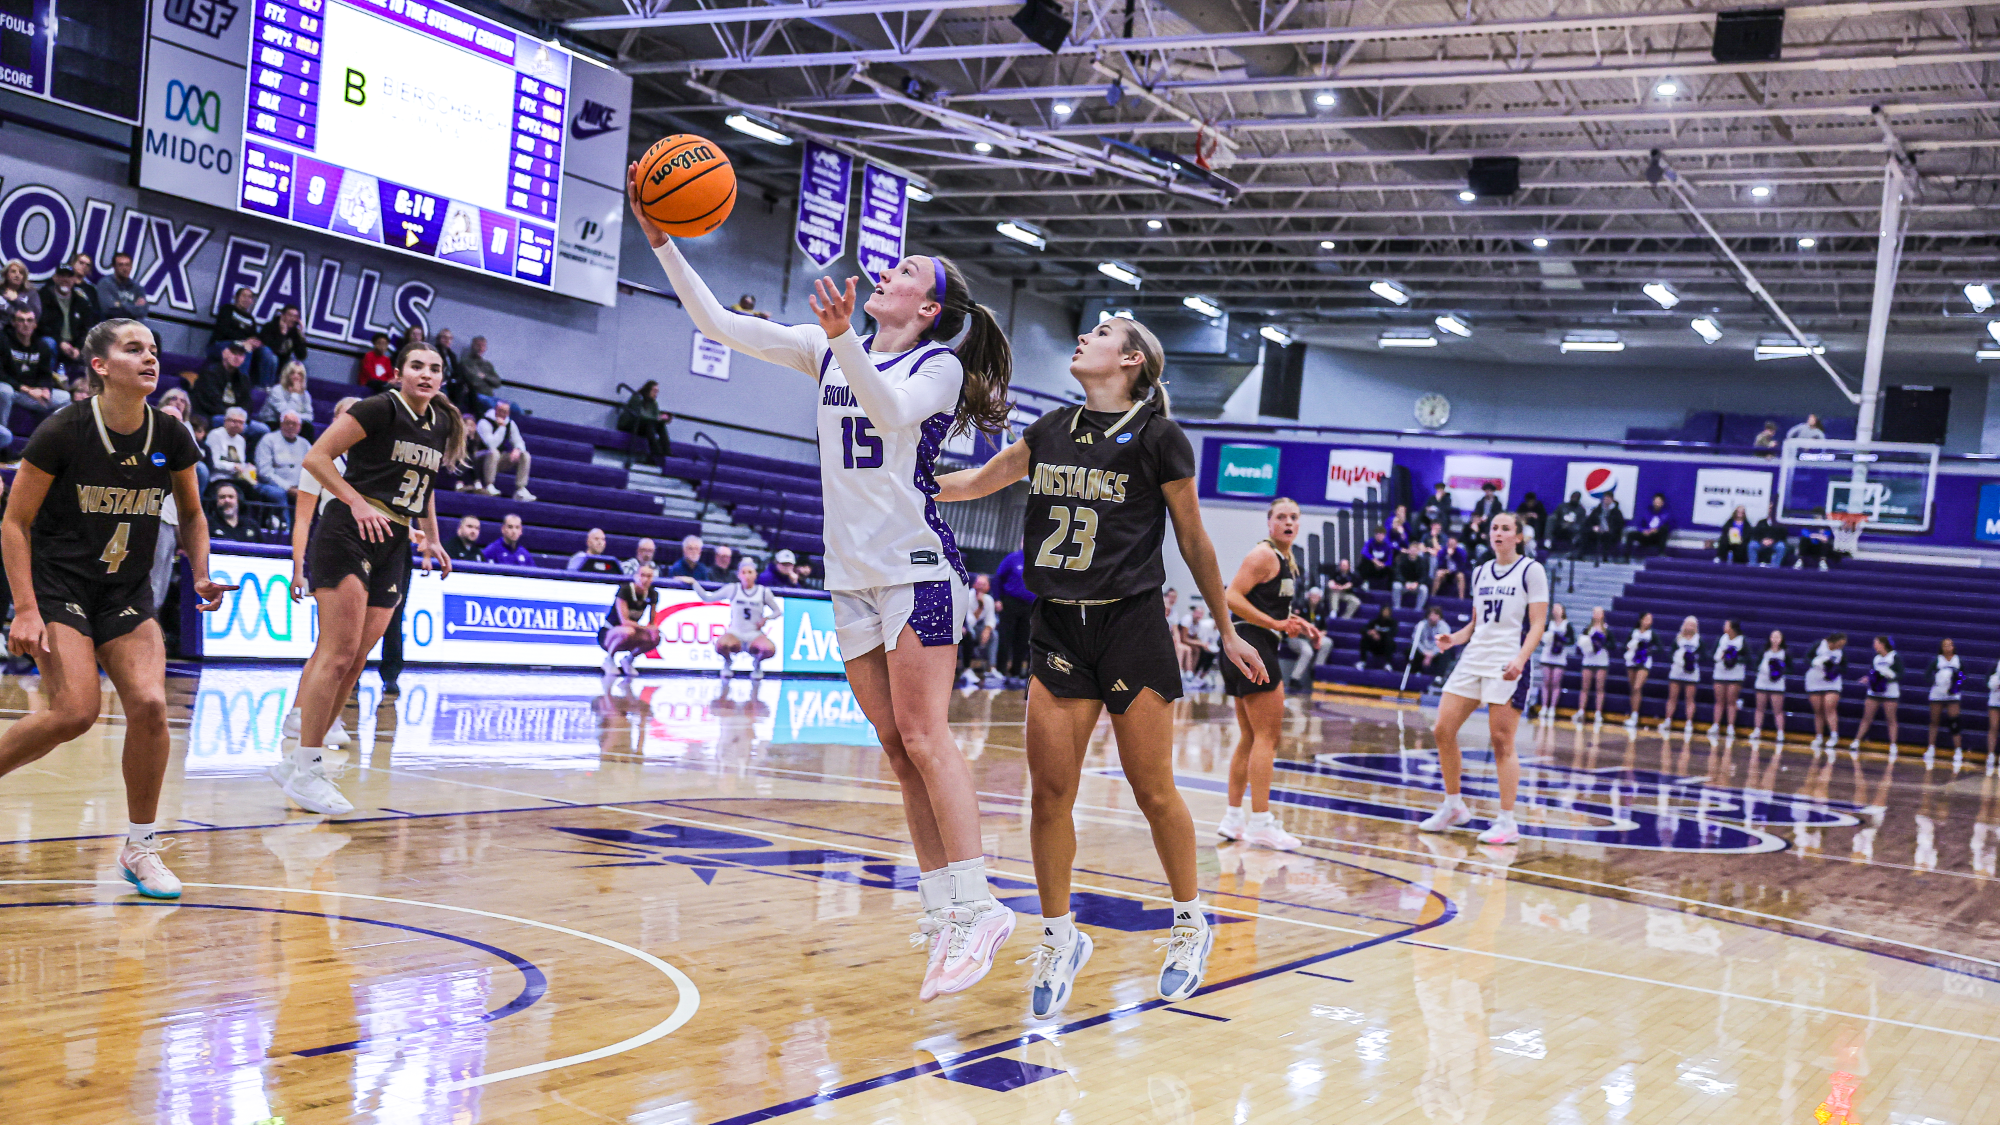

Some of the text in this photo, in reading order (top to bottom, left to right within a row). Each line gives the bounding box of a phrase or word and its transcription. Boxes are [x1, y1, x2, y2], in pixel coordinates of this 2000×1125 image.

[344, 67, 367, 107] B
[579, 99, 616, 130] NIKE
[146, 128, 232, 174] MIDCO
[649, 144, 717, 186] Wilson
[306, 175, 327, 206] 9
[394, 189, 436, 222] 6:14
[211, 235, 435, 352] FALLS
[841, 416, 884, 470] 15
[1028, 462, 1130, 504] MUSTANGS
[99, 522, 131, 574] 4
[1035, 505, 1099, 572] 23
[464, 600, 559, 631] DACOTAH
[743, 608, 752, 620] 5
[1483, 599, 1503, 624] 24
[790, 612, 843, 662] Ave
